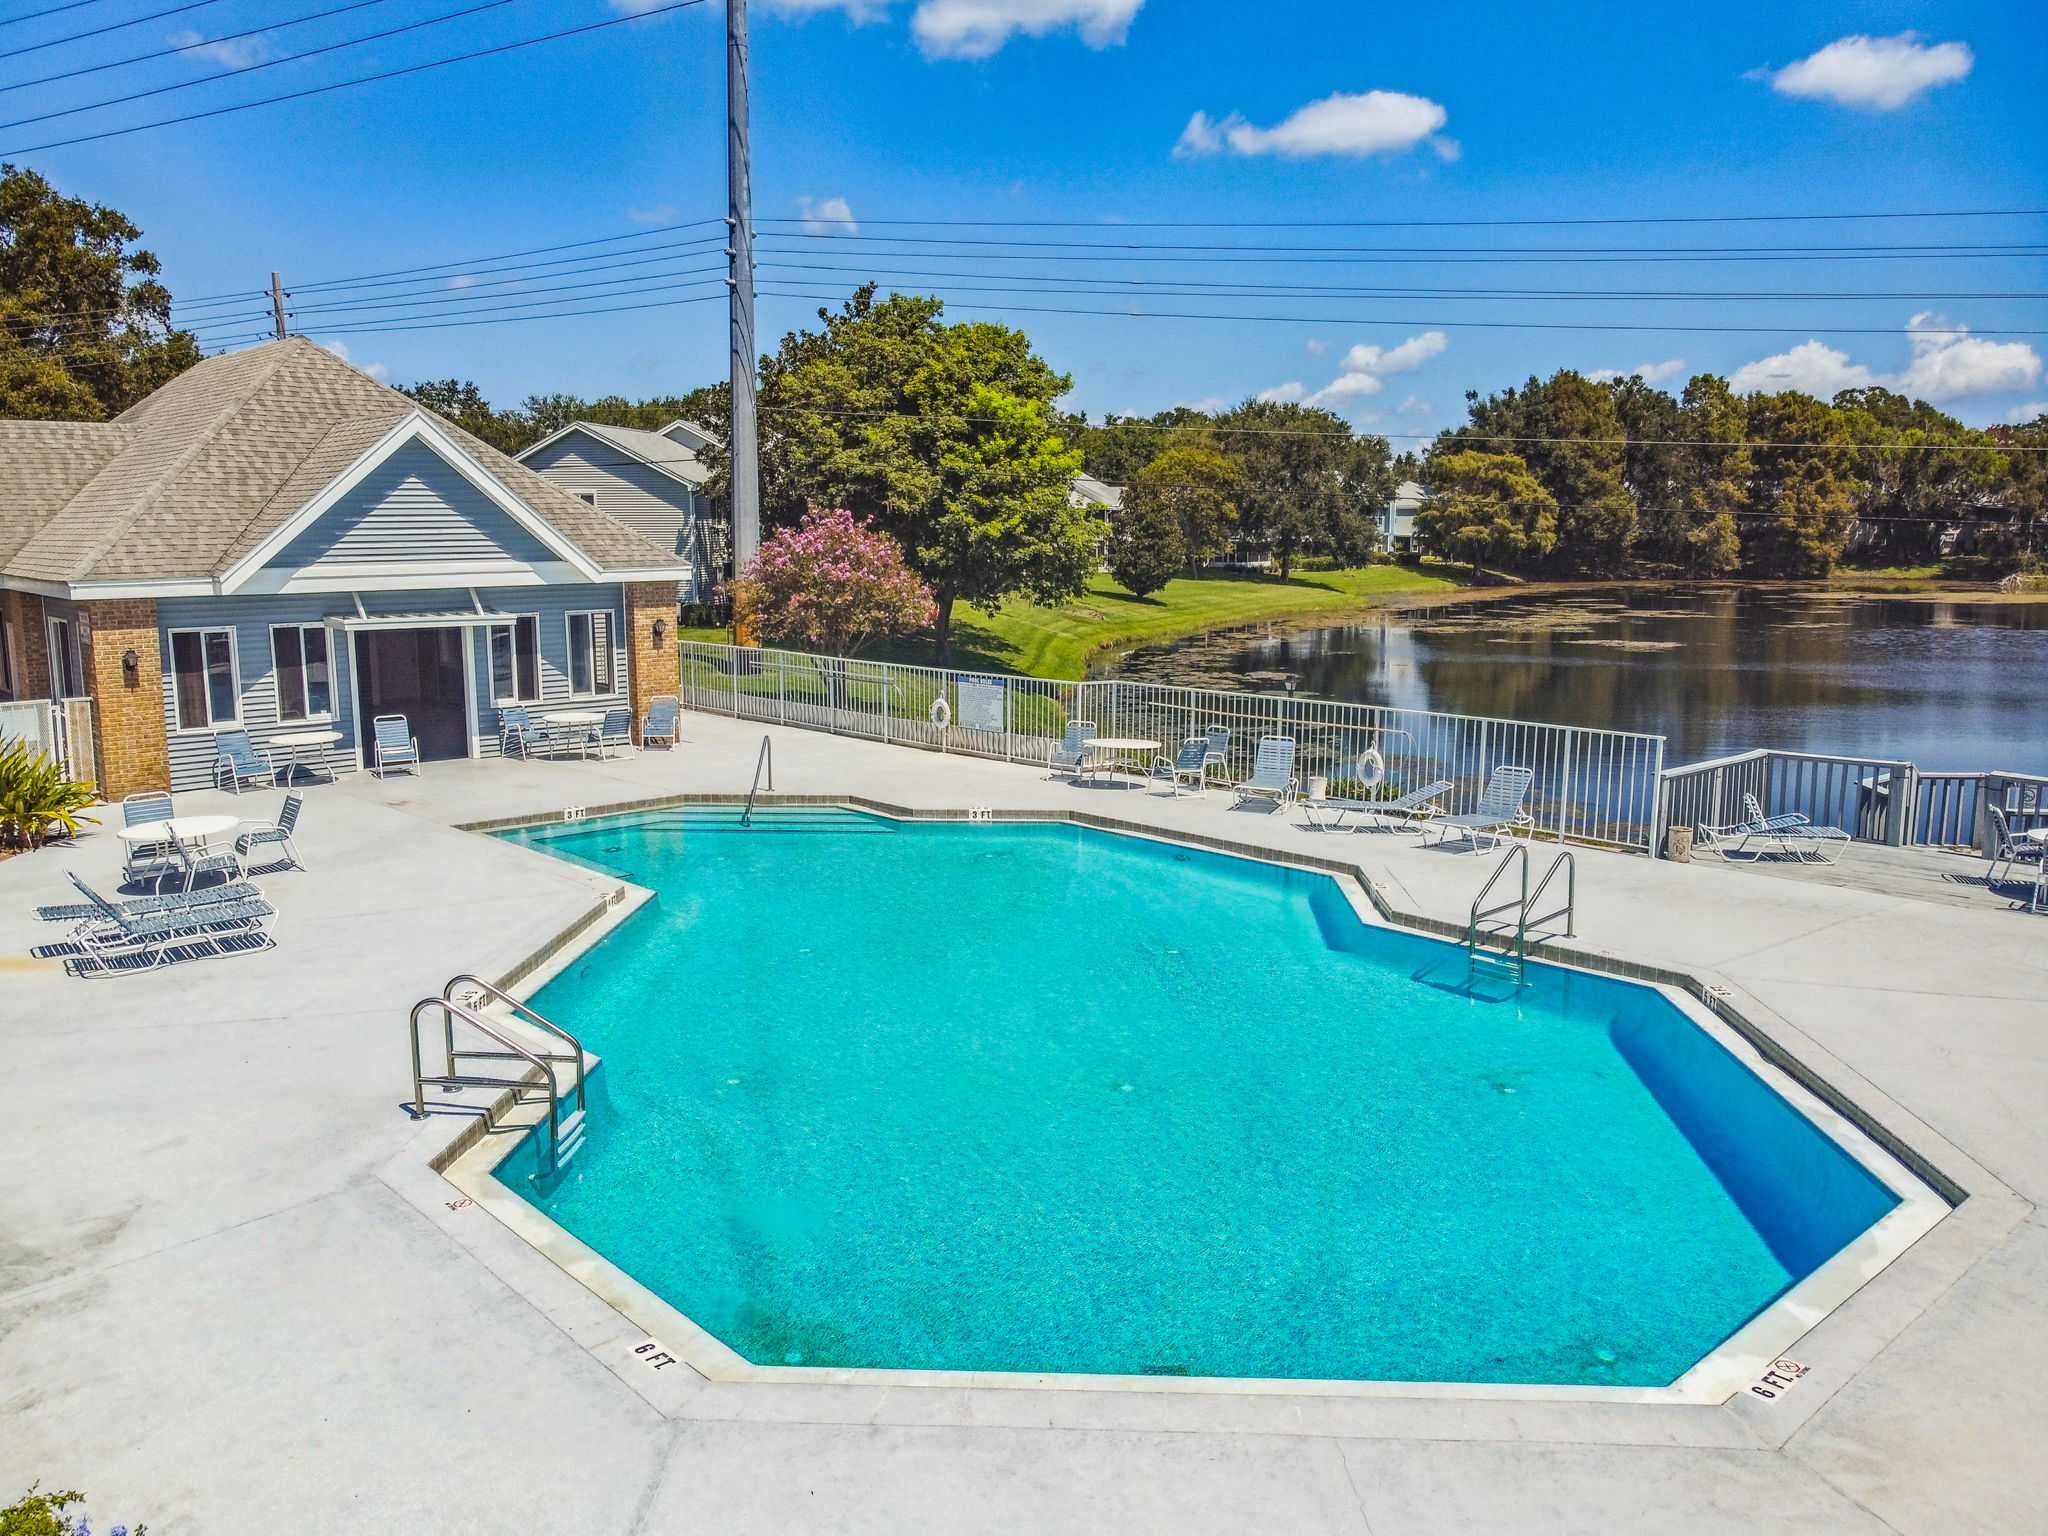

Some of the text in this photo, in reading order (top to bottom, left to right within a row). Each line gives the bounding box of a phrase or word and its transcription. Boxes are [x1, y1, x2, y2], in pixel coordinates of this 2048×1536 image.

[567, 811, 572, 819] 3
[634, 1343, 656, 1354] 6
[1751, 1386, 1776, 1399] 6
